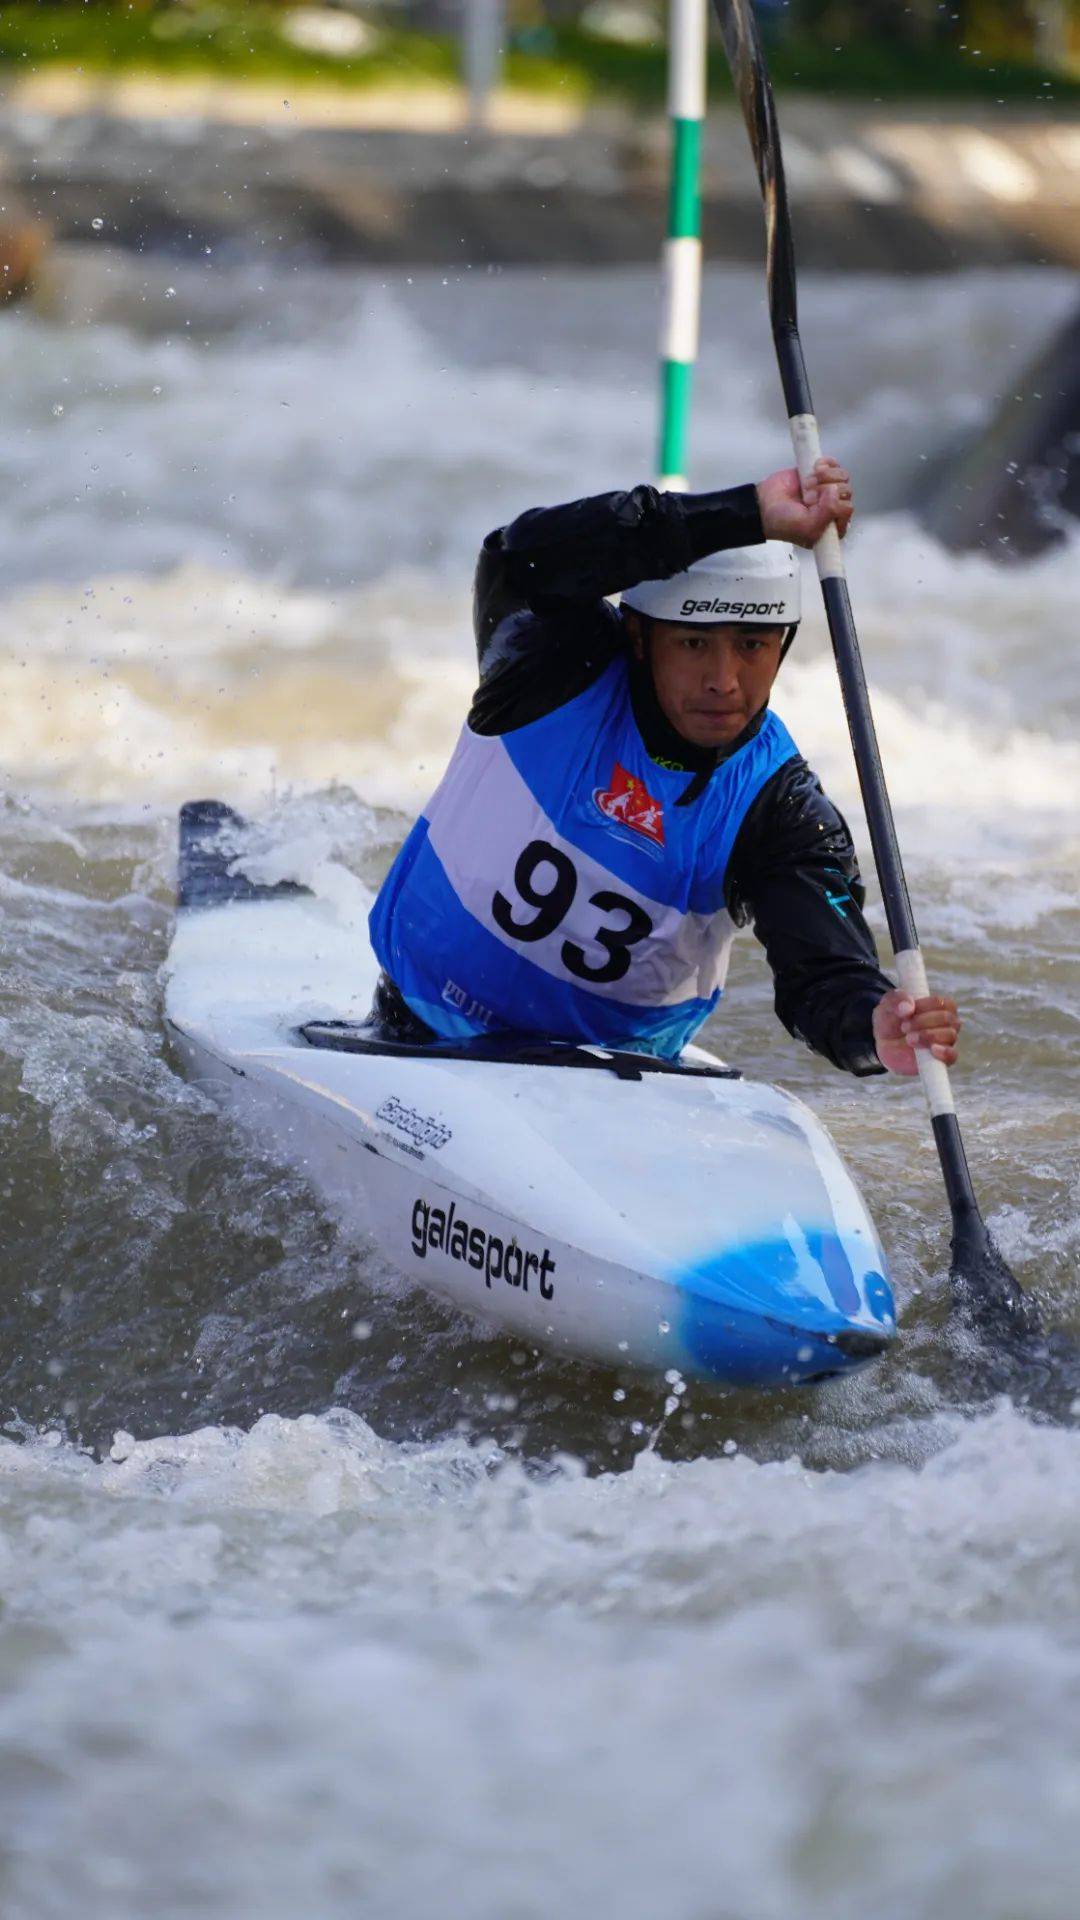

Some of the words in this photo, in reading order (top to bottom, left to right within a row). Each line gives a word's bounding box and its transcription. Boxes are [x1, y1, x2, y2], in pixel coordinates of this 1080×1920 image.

[680, 598, 786, 618] galasport
[491, 839, 653, 984] 93
[411, 1198, 556, 1300] galasport
